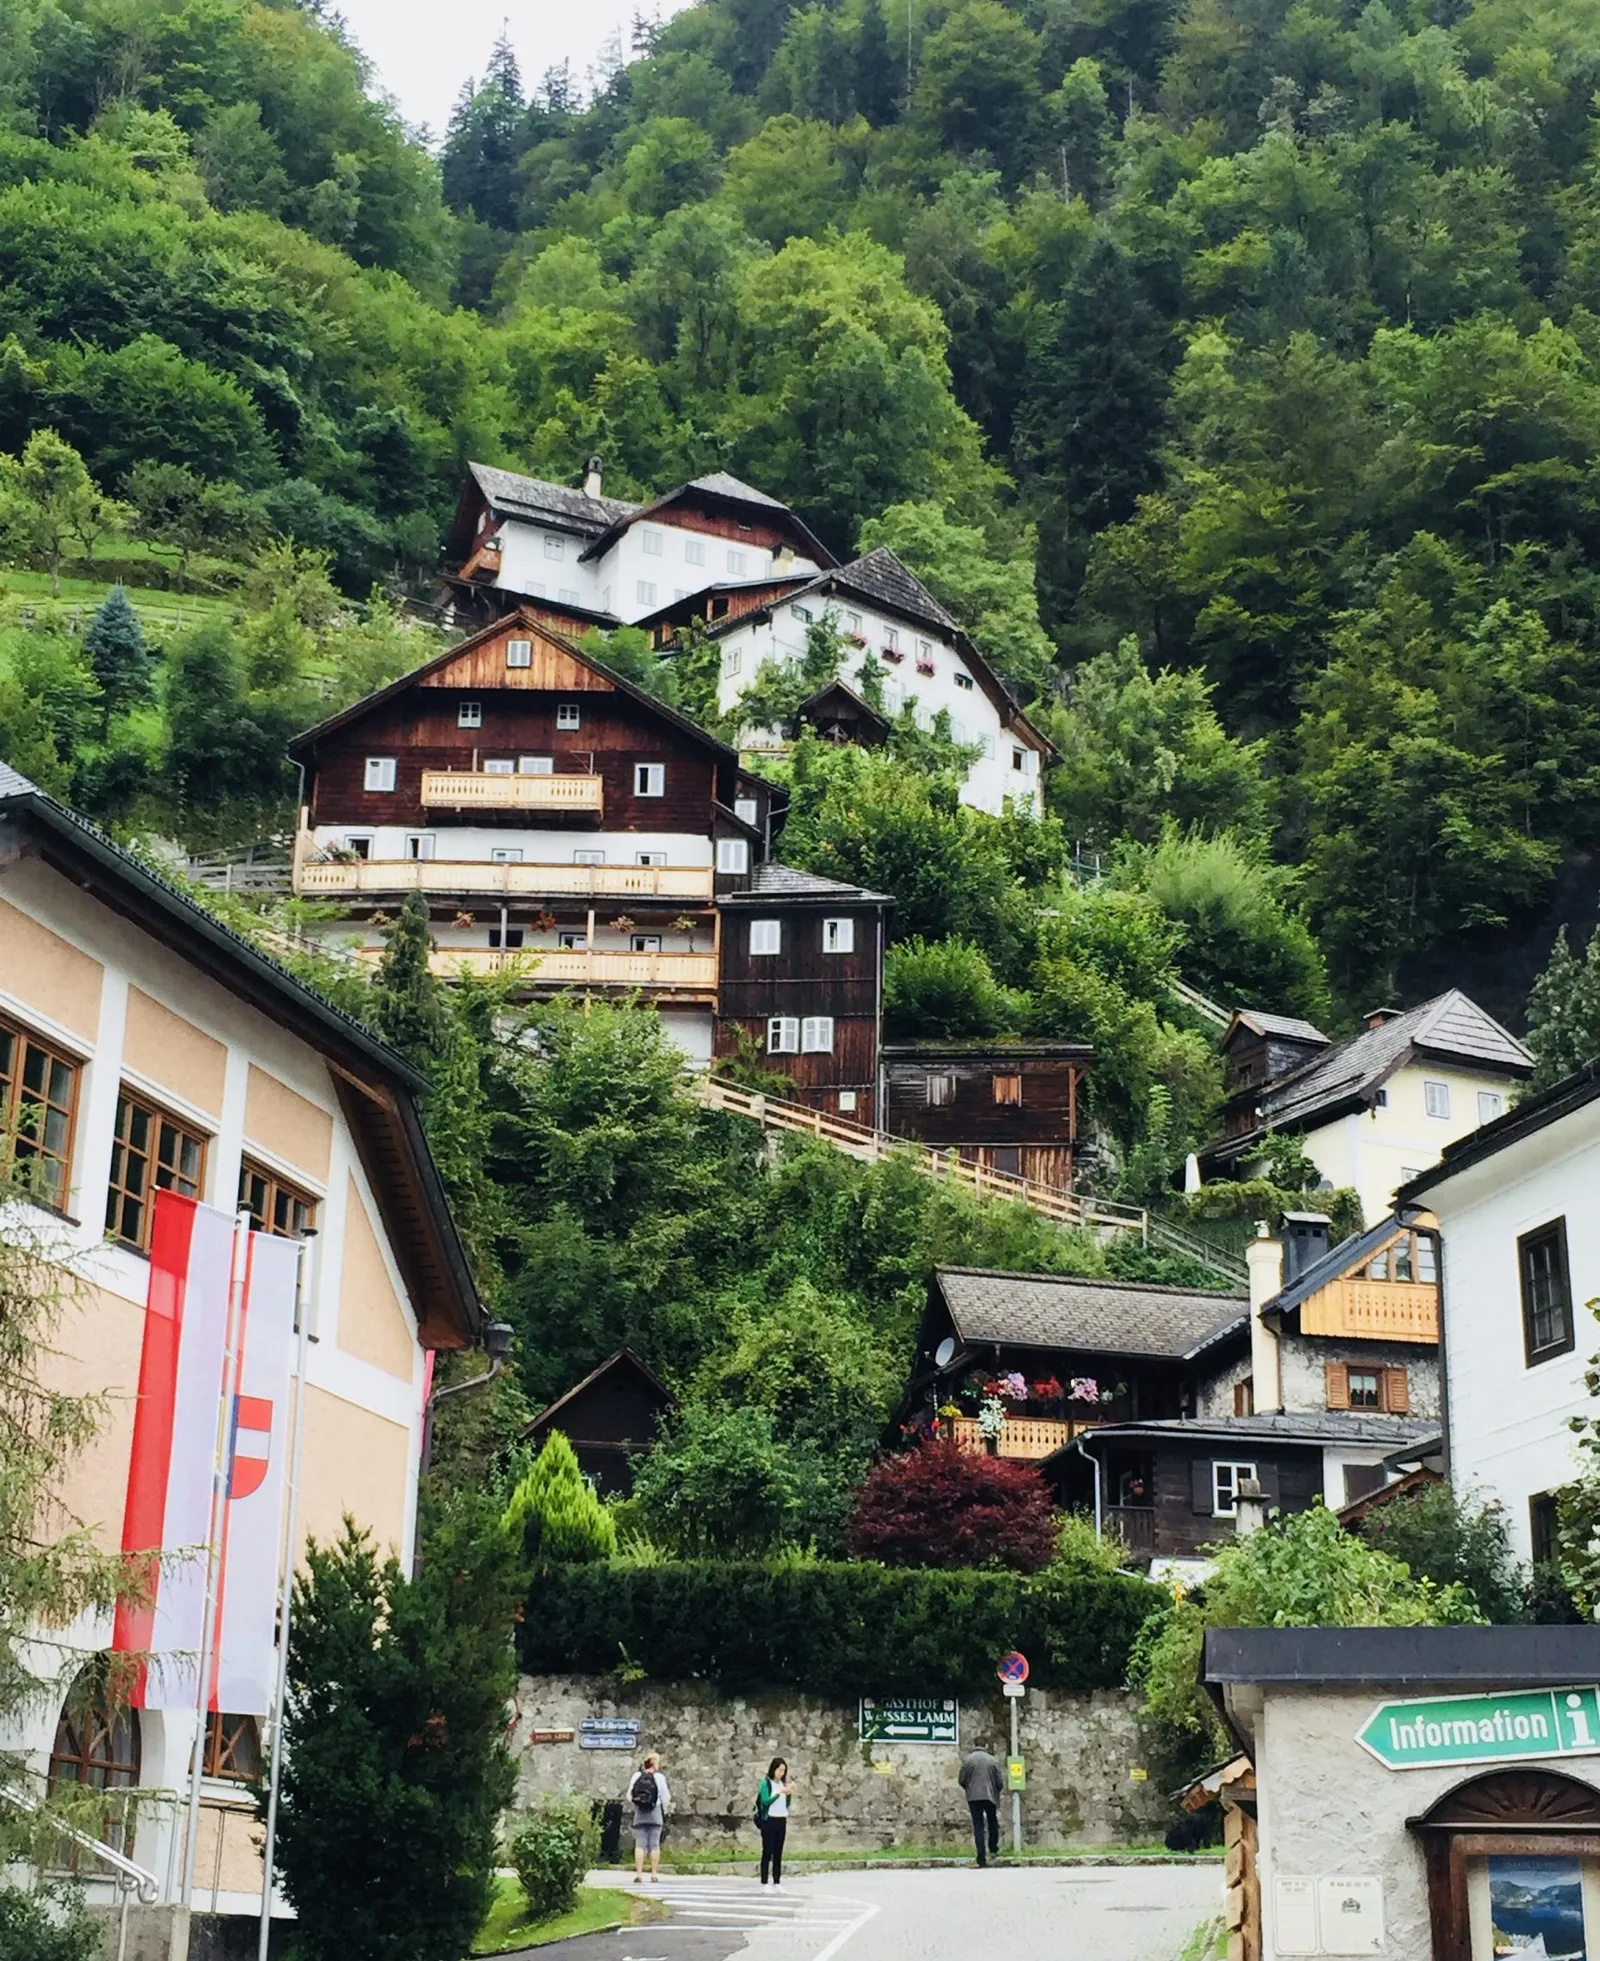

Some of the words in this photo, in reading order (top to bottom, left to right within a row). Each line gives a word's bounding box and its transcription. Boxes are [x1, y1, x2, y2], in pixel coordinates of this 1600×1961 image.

[917, 1712, 954, 1724] LAMM
[1389, 1709, 1549, 1750] Information
[1566, 1694, 1596, 1747] i
